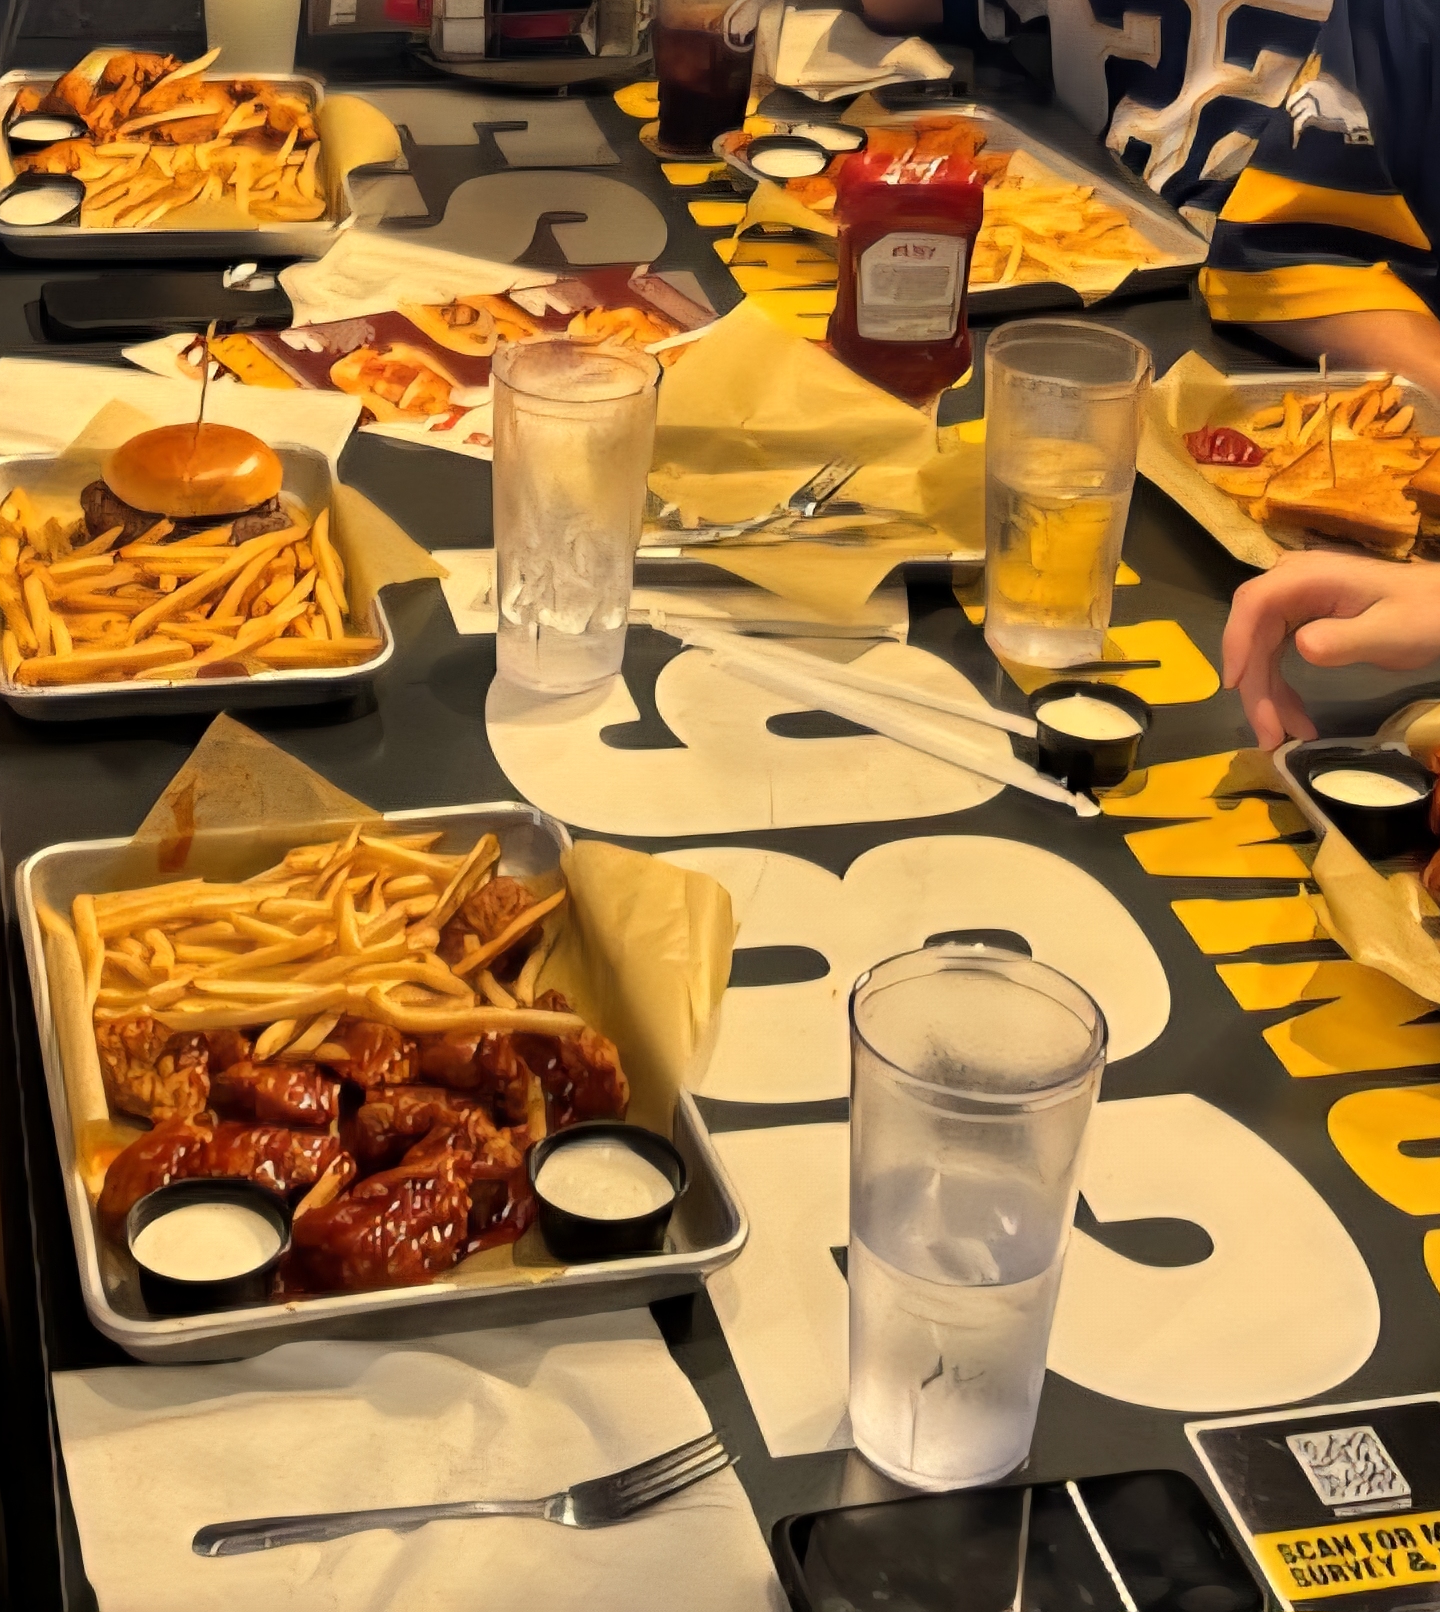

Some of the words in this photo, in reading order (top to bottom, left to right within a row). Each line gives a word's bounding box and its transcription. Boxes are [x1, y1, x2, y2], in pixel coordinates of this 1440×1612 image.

[1277, 1534, 1357, 1565] SCAN
[1359, 1527, 1417, 1554] FOR
[1290, 1552, 1396, 1587] SURVEY
[1407, 1551, 1437, 1571] &
